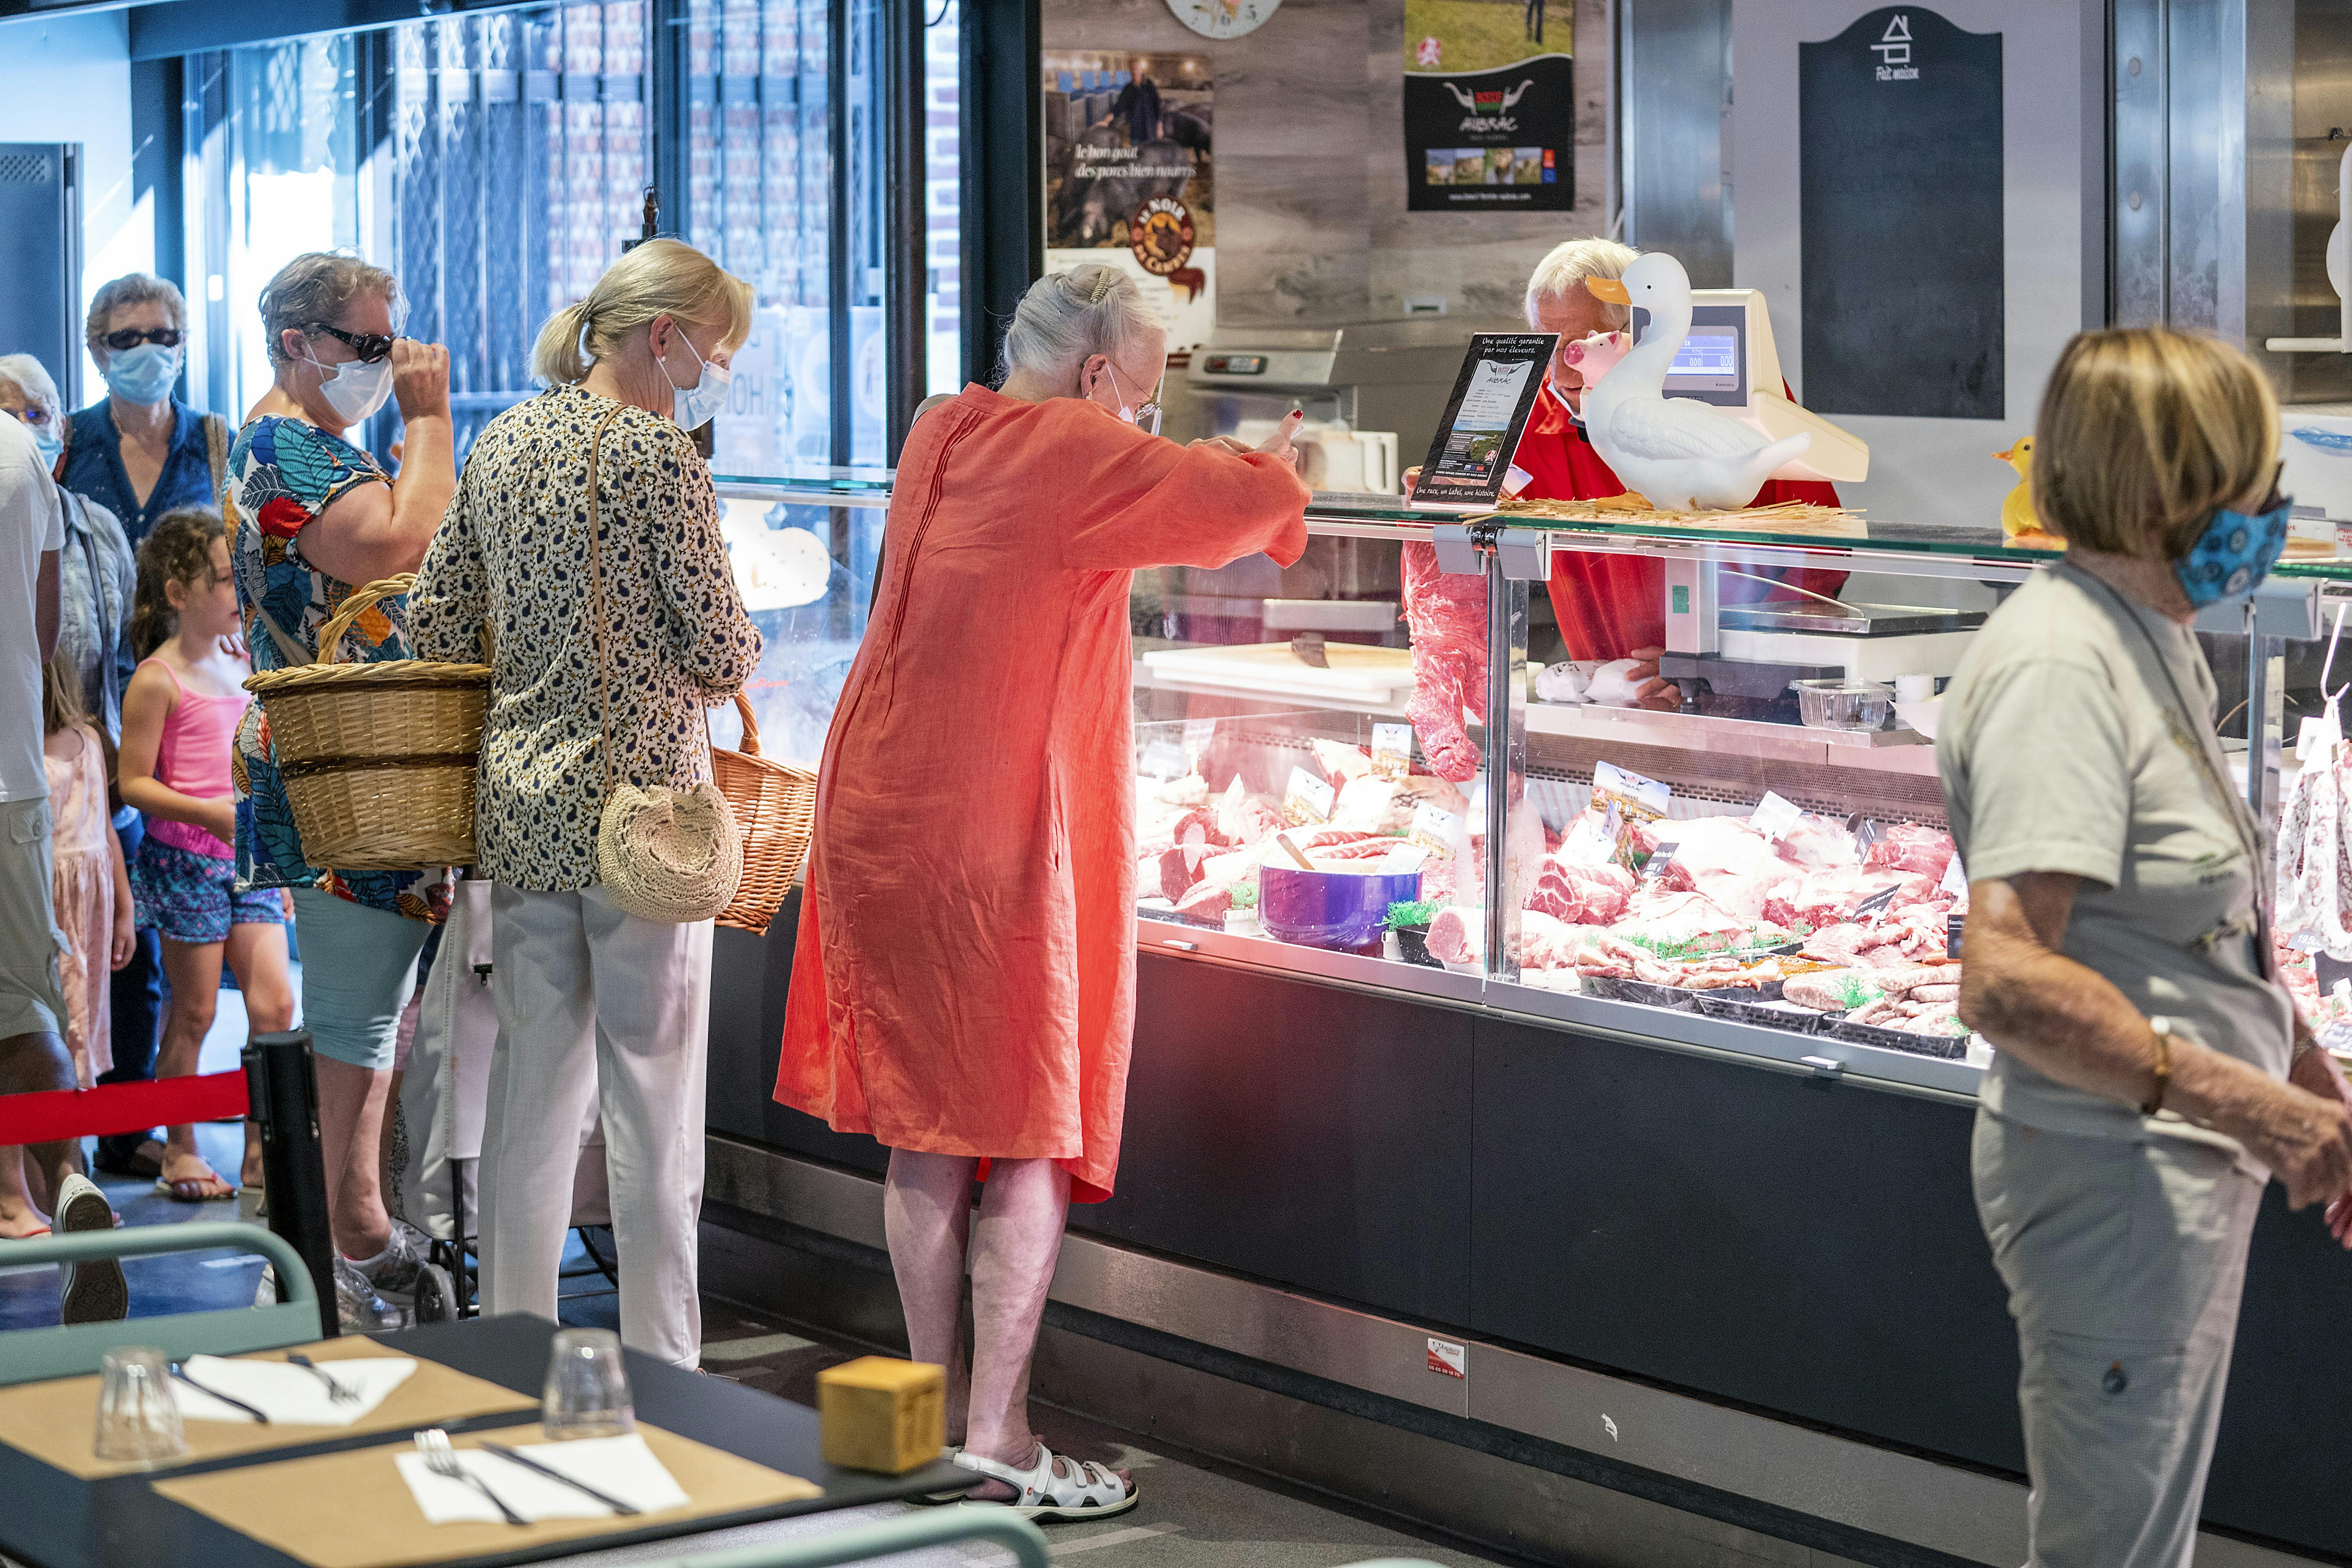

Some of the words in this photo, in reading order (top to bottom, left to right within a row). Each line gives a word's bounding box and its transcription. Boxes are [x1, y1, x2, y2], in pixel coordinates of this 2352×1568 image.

[1074, 162, 1096, 178] des
[1128, 162, 1154, 177] bien
[1496, 336, 1518, 347] qualité
[1519, 338, 1544, 347] garantie
[1483, 347, 1495, 356] par
[1448, 487, 1462, 496] Label,
[1475, 488, 1495, 496] histoire.
[1619, 782, 1642, 793] AUBRAC
